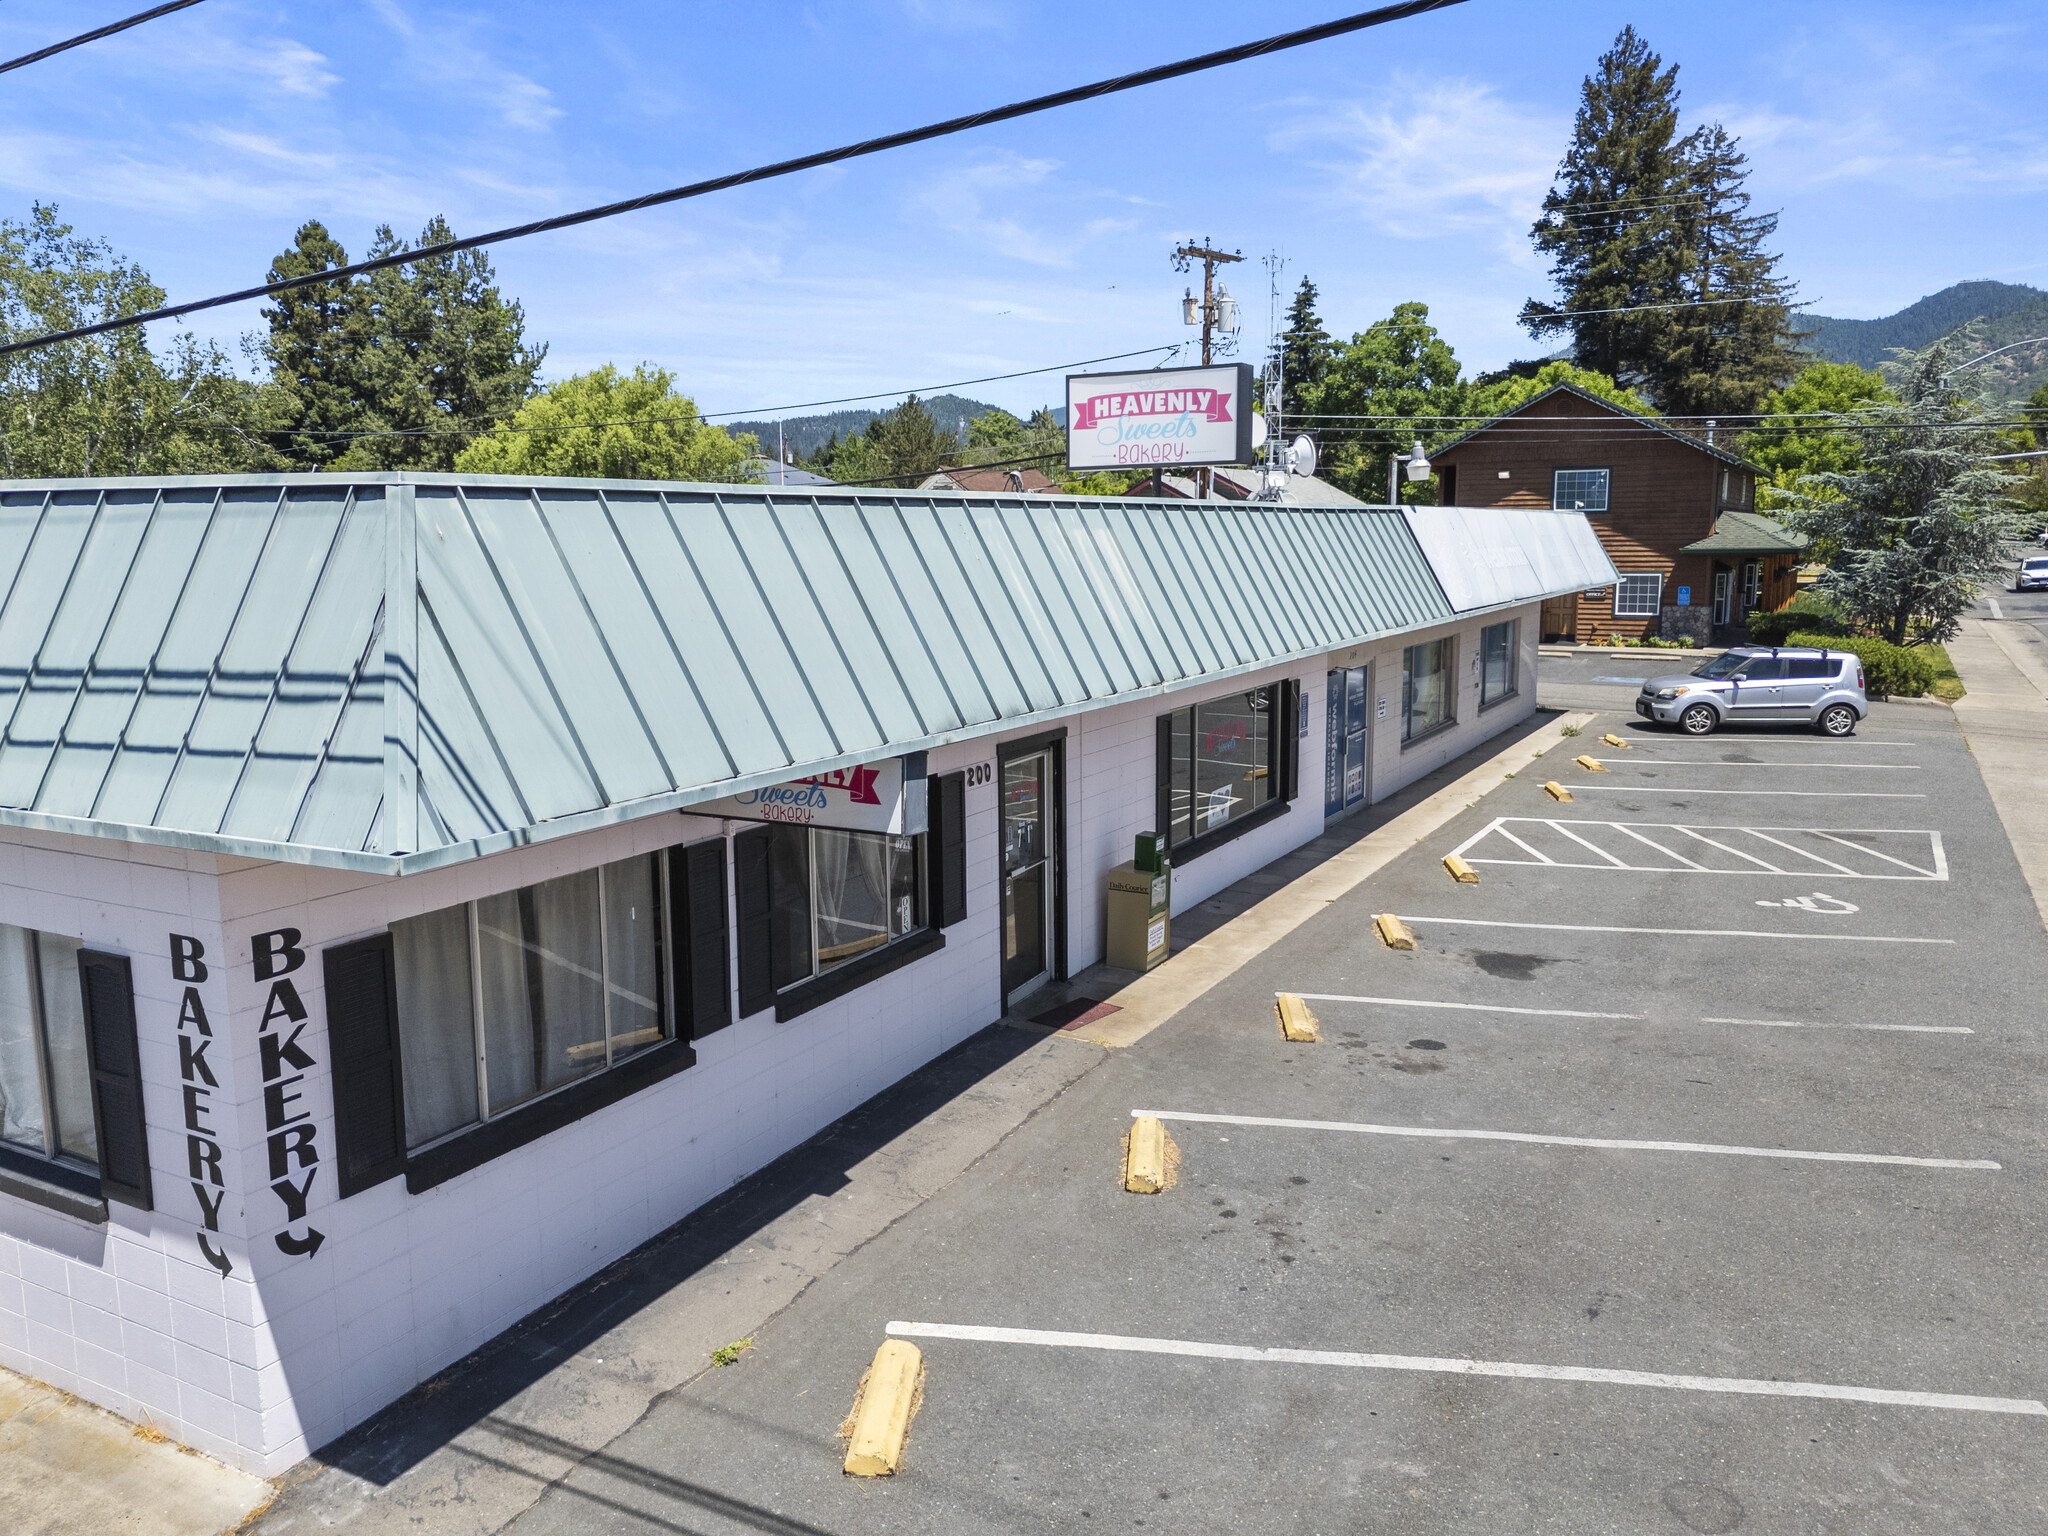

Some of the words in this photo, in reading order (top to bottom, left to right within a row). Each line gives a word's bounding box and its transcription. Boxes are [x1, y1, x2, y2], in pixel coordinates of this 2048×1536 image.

[1094, 391, 1212, 418] HEAVENLY
[1097, 411, 1197, 445] Sweets
[966, 763, 992, 787] 200
[169, 932, 225, 1232] BAKERY
[251, 927, 320, 1222] BAKERY
